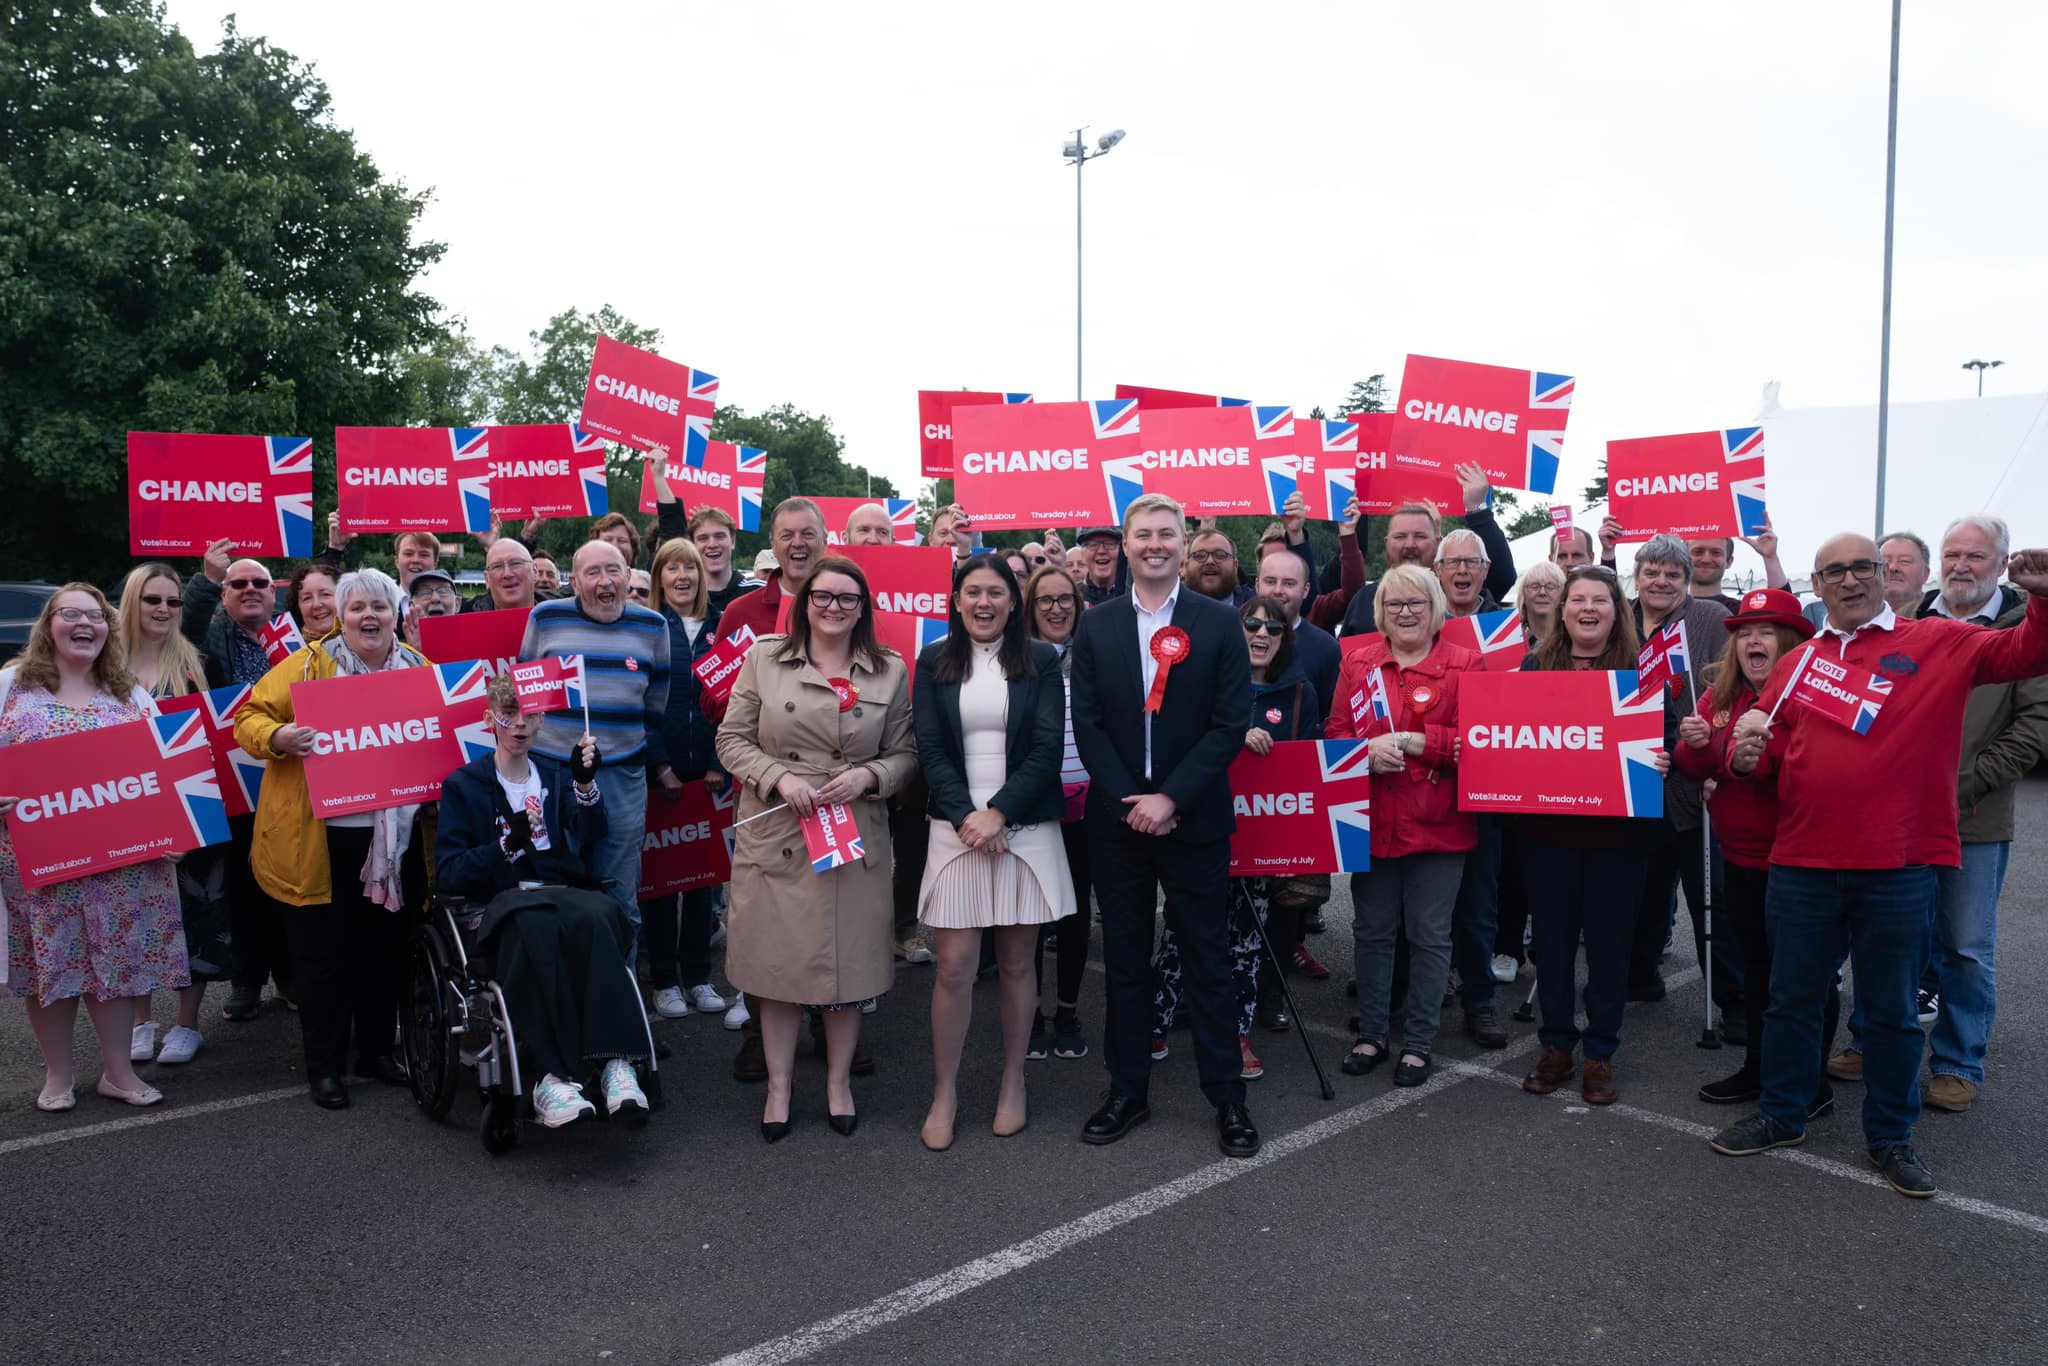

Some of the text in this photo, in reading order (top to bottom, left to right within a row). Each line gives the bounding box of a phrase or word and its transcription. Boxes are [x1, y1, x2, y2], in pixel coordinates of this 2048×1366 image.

[594, 374, 681, 416] CHANGE
[1405, 399, 1518, 435] CHANGE
[963, 447, 1089, 474] CHANGE
[1141, 446, 1250, 469] CHANGE
[1417, 457, 1441, 468] Labour
[345, 467, 448, 486] CHANGE
[664, 463, 731, 489] HANGE
[1492, 470, 1508, 479] July
[1615, 472, 1719, 497] CHANGE
[138, 479, 262, 503] CHANGE
[1199, 500, 1231, 508] Thursday
[1237, 499, 1251, 508] July
[401, 518, 430, 526] Thursday
[435, 518, 448, 526] July
[990, 513, 1016, 521] Labour
[1031, 511, 1067, 520] Thursday
[1075, 510, 1091, 519] July
[1669, 526, 1700, 534] Thursday
[1706, 525, 1720, 533] July
[140, 539, 160, 547] Vote
[247, 540, 262, 549] July
[877, 591, 947, 614] ANGE
[516, 668, 541, 679] VOTE
[699, 656, 720, 674] VOTE
[704, 656, 743, 688] Labour
[1640, 651, 1664, 681] Labour
[1816, 660, 1844, 678] VOTE
[517, 680, 564, 696] Labour
[1803, 671, 1859, 705] Labour
[312, 716, 442, 755] CHANGE
[1468, 725, 1604, 750] CHANGE
[16, 771, 161, 823] CHANGE
[322, 792, 377, 807] Vote Labour
[391, 784, 428, 797] Thursday
[1468, 792, 1522, 802] Vote Labour
[1538, 794, 1603, 807] Thursday 4 July
[833, 802, 846, 823] OTE
[1233, 792, 1314, 817] ANGE
[643, 820, 712, 852] ANGE
[816, 806, 838, 847] abour
[107, 837, 173, 859] Thursday 4 July
[31, 856, 92, 877] Vote Labour
[1254, 857, 1291, 866] Thursday
[1298, 856, 1316, 865] July
